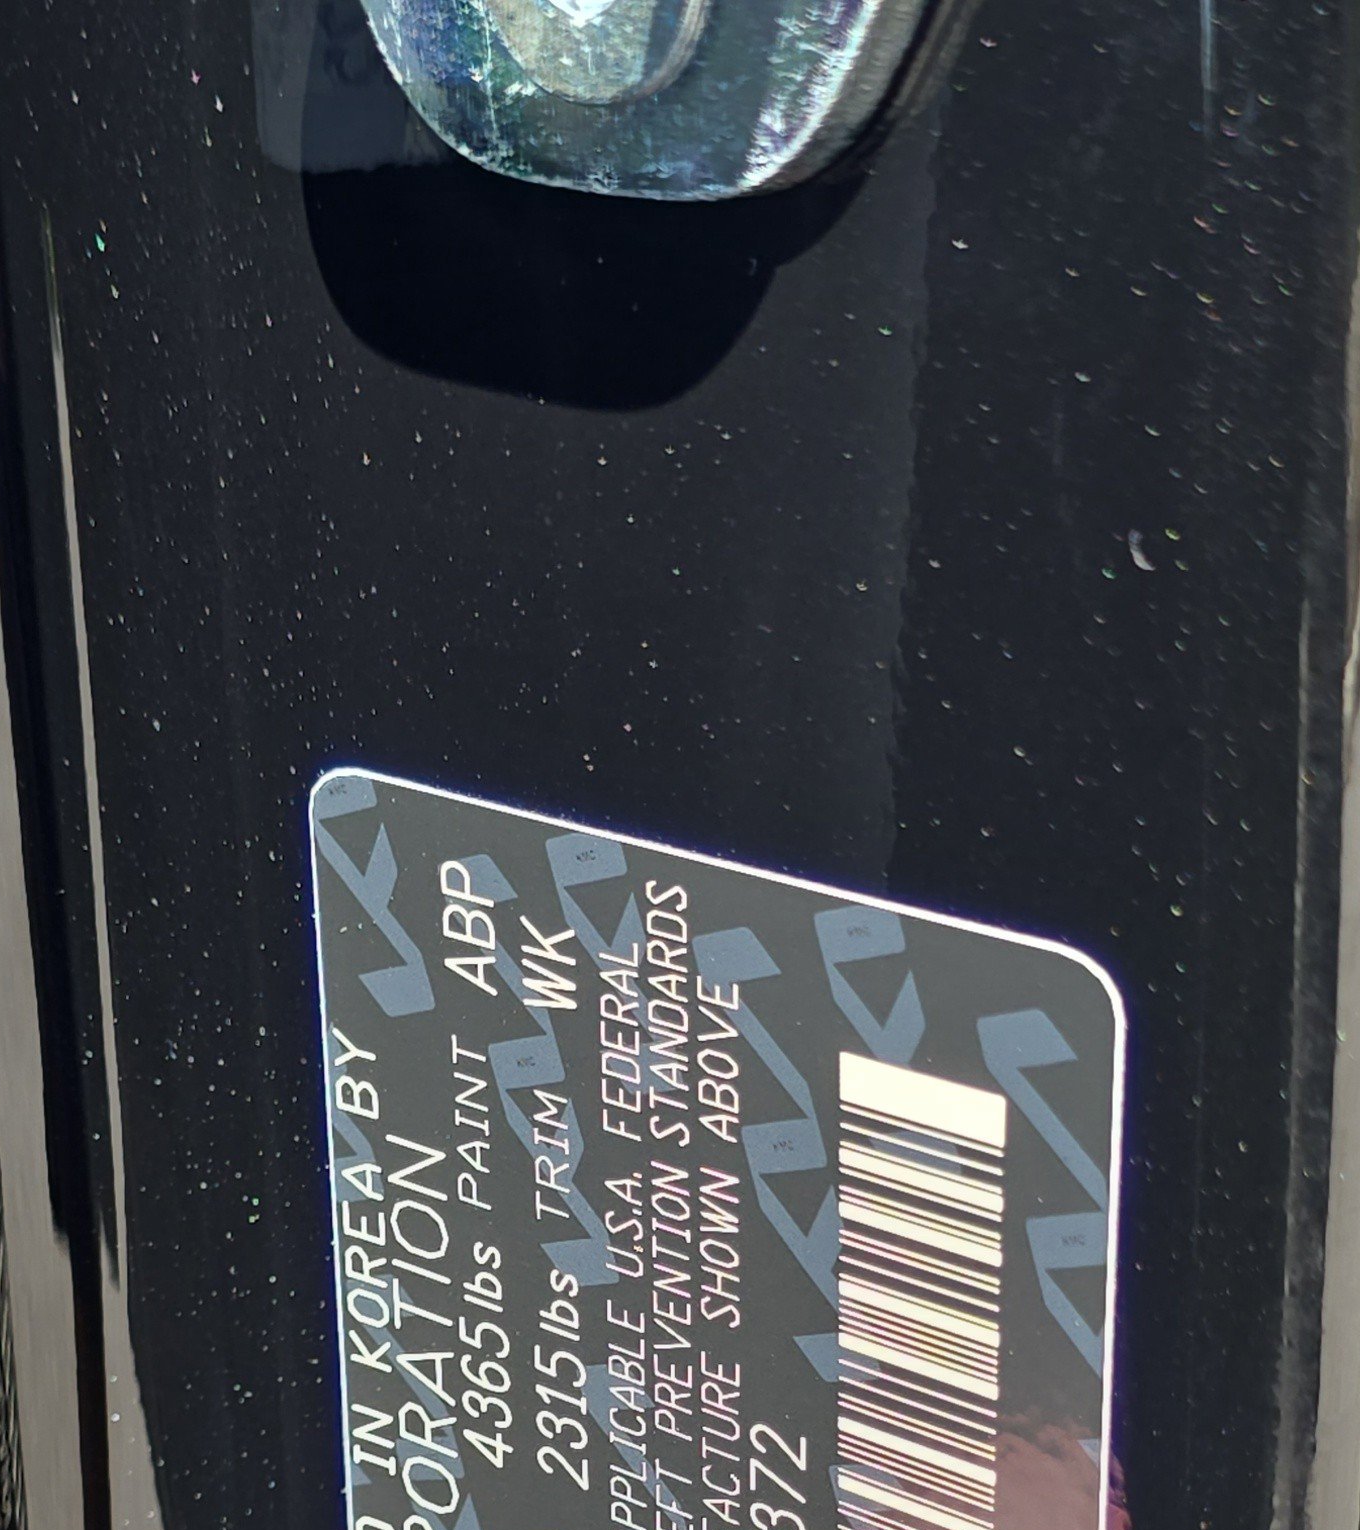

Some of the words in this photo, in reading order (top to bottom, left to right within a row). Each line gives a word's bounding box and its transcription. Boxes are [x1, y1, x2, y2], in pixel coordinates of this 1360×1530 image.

[439, 856, 500, 997] ABP
[518, 913, 579, 1011] WK
[331, 1025, 381, 1119] BY
[598, 940, 642, 1141] FEDERAL
[644, 877, 691, 1147] STANDARDS
[696, 973, 740, 1144] ABOVE
[450, 1032, 493, 1211] PAINT
[531, 1088, 572, 1220] TRIM
[340, 1159, 393, 1372] KOREA
[602, 1170, 645, 1277] U.S.A.
[649, 1158, 694, 1441] PREVENTION
[698, 1165, 741, 1328] SHOWN
[350, 1402, 397, 1475] IN
